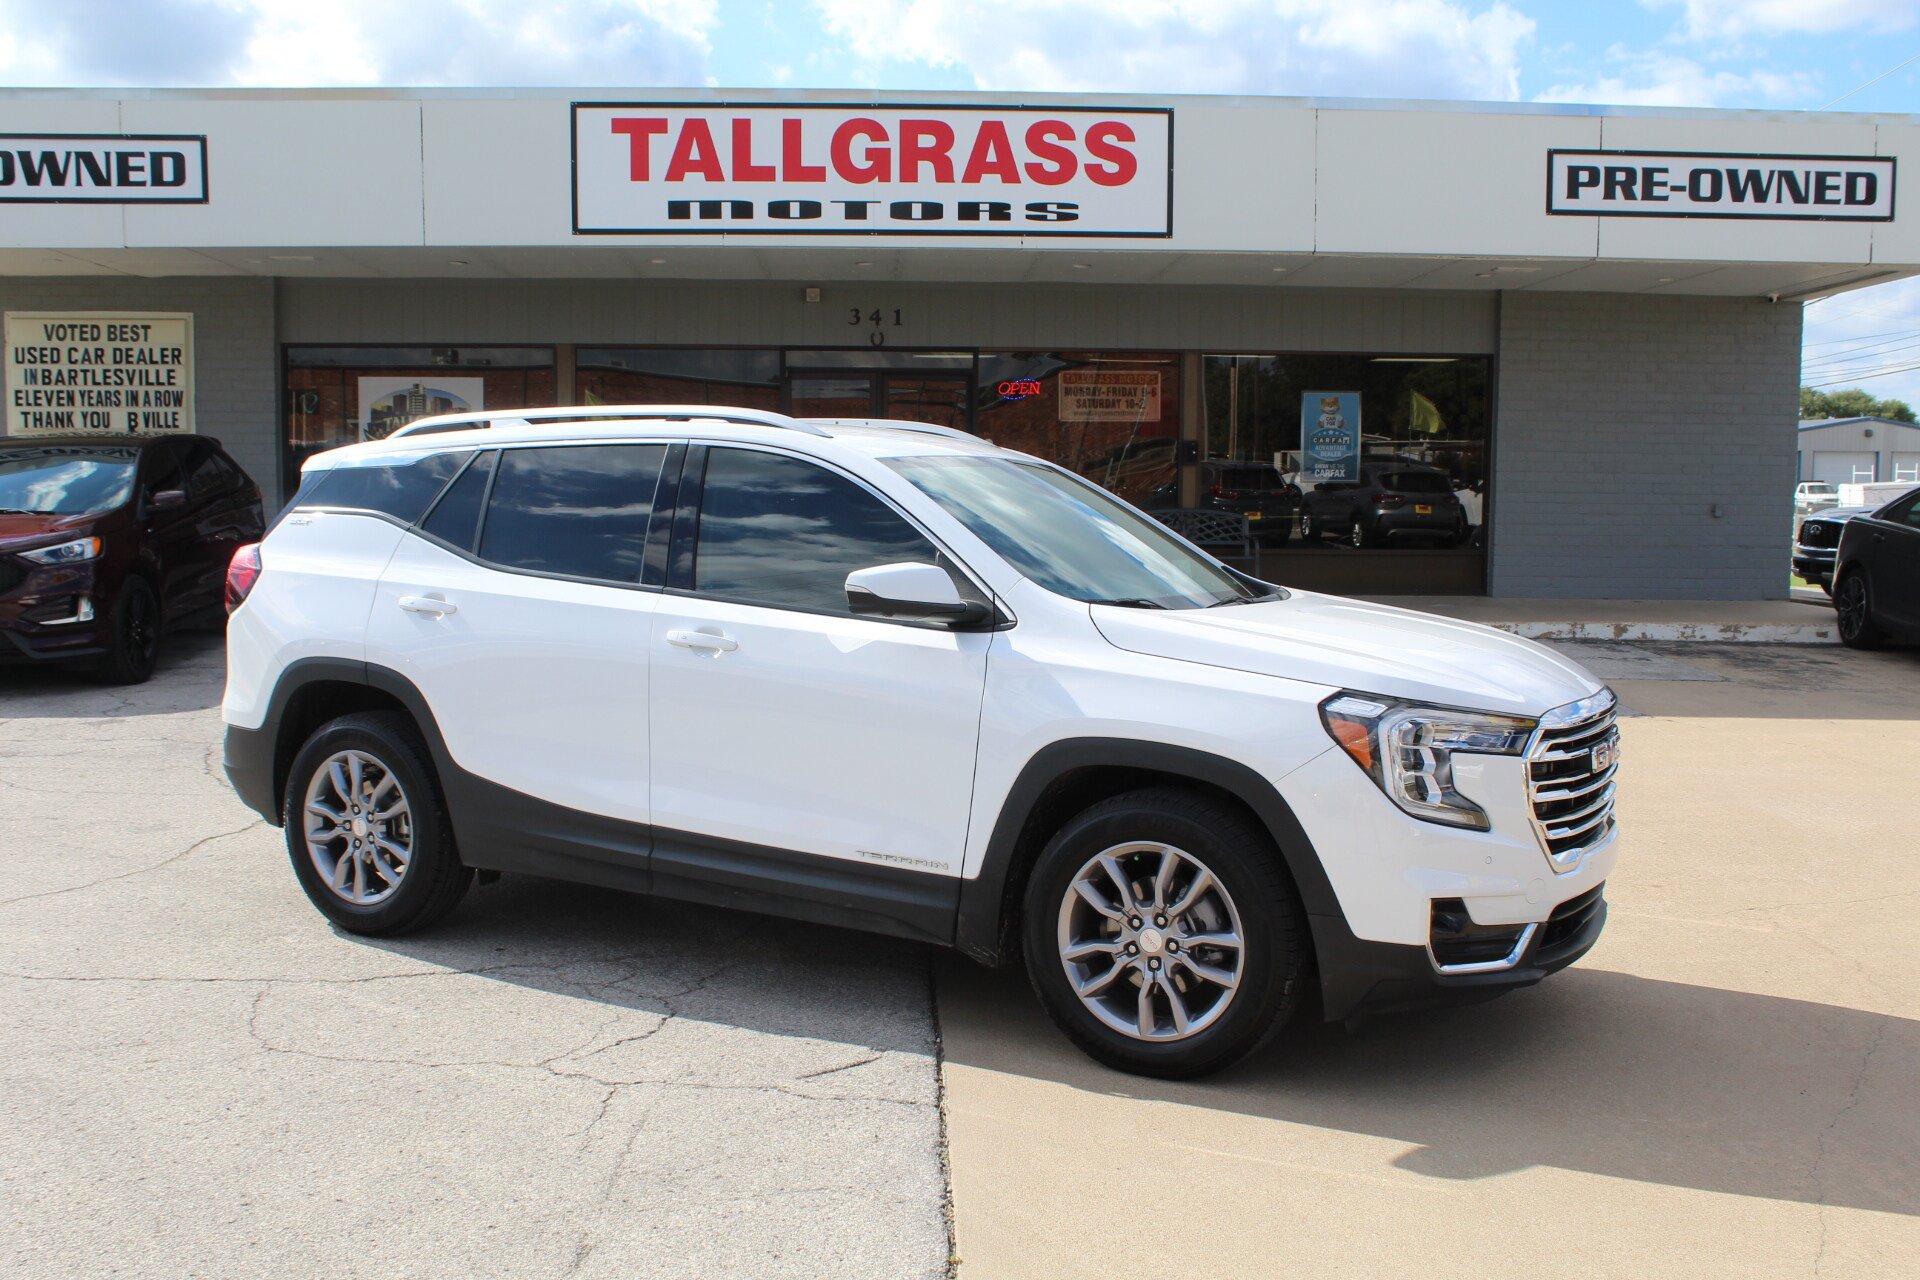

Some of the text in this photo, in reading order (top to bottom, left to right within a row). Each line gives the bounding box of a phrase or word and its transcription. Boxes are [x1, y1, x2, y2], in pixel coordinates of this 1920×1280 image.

[611, 117, 1138, 187] TALLGRASS
[1565, 164, 1878, 206] PRE-OWNED
[667, 200, 1080, 222] MOTORS
[848, 308, 903, 328] 341
[44, 324, 152, 342] VOTED BEST
[14, 347, 182, 365] USED CAR DEALER
[24, 368, 176, 386] IN BARTLESVILLE
[998, 381, 1042, 396] OPEN
[14, 389, 184, 408] ELEVEN YEARS IN A ROW
[1075, 398, 1122, 409] SATURDAY
[20, 411, 74, 429] THANK
[80, 411, 111, 429] YOU
[1314, 469, 1345, 478] CARFAX
